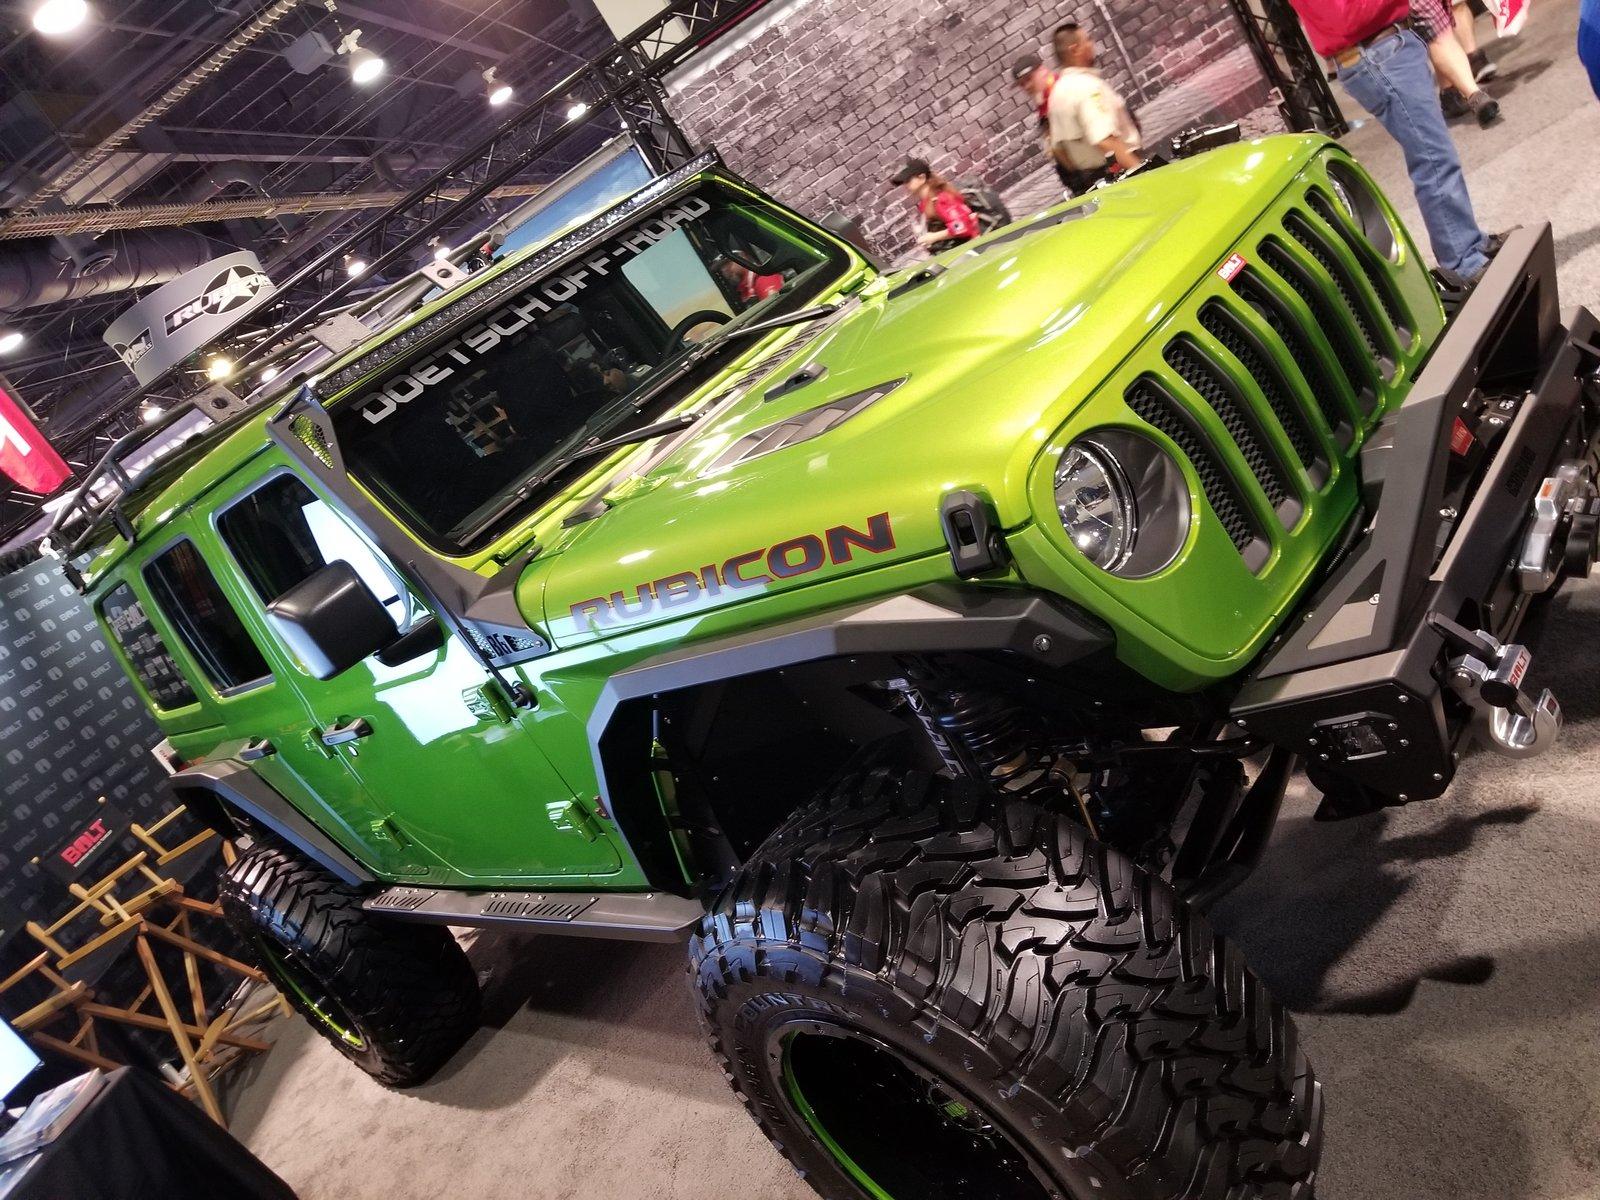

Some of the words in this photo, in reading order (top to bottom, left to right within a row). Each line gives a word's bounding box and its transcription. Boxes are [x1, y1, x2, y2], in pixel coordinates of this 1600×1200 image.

[351, 294, 553, 425] DOETSCH
[541, 196, 711, 302] OFF-ROAD
[569, 512, 897, 632] RUBICON
[61, 818, 106, 865] BOLT
